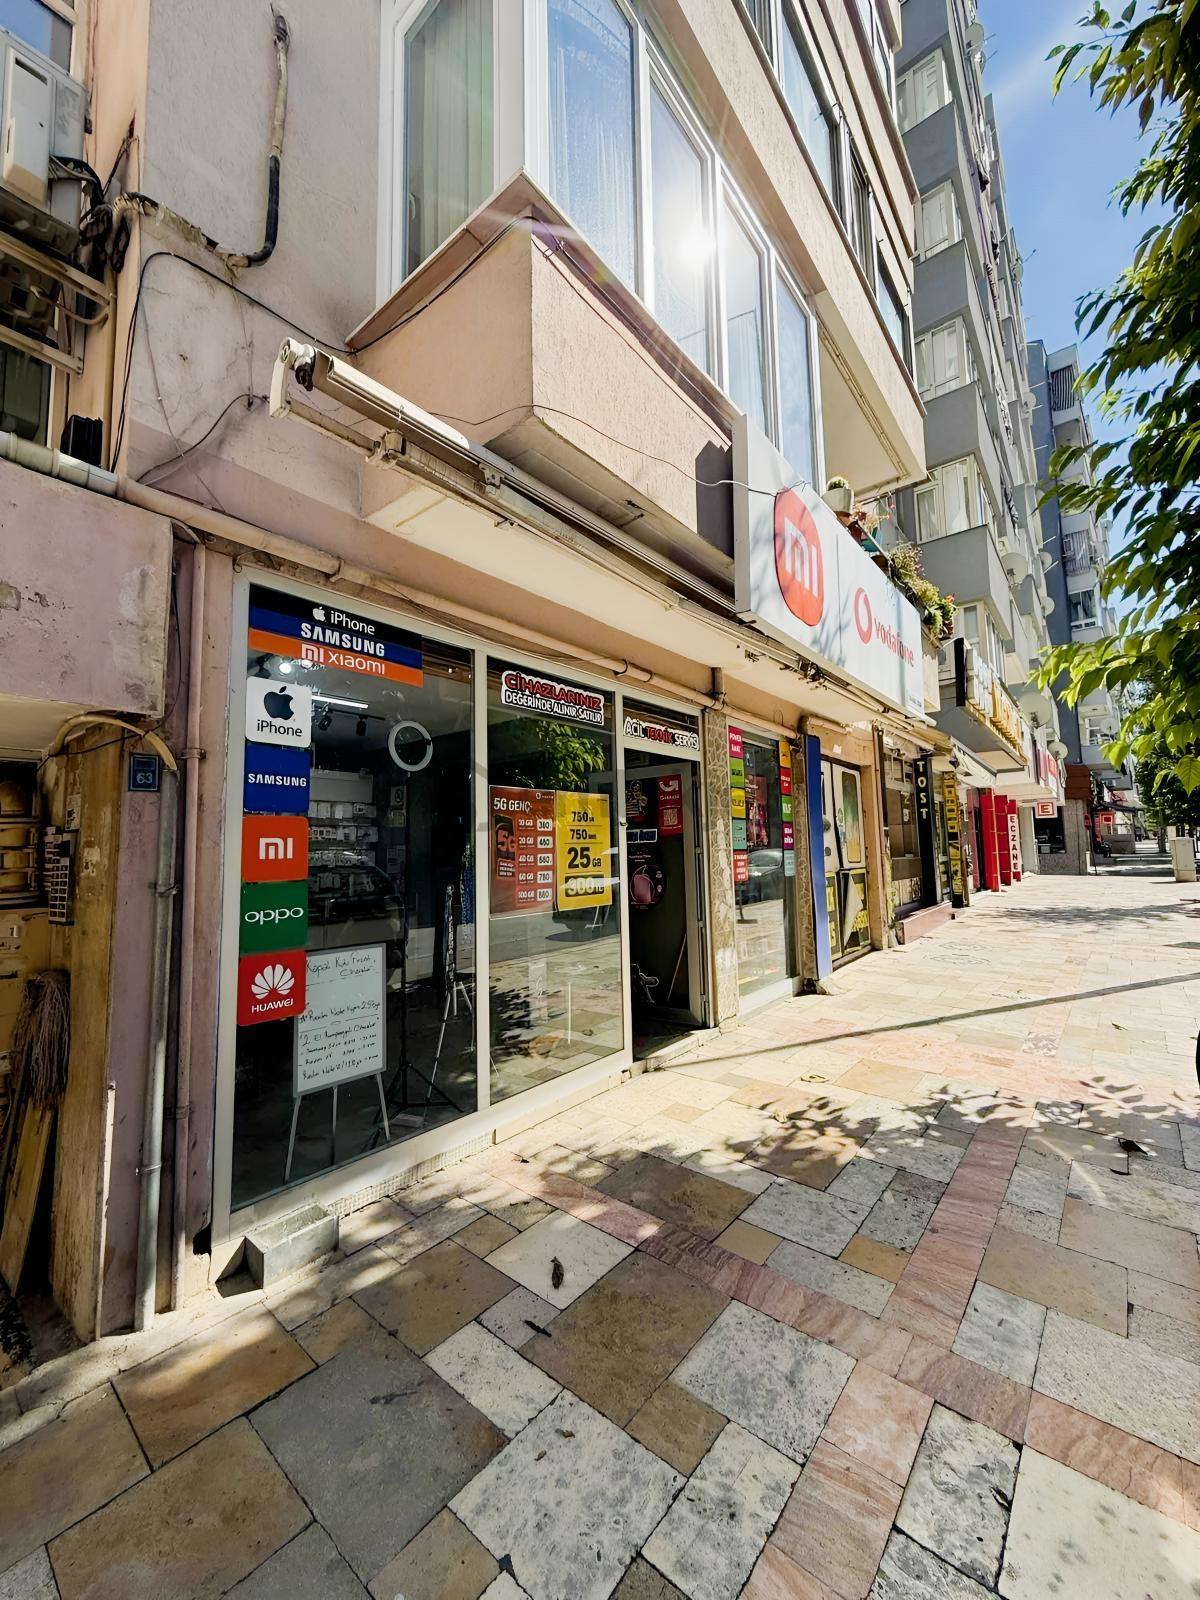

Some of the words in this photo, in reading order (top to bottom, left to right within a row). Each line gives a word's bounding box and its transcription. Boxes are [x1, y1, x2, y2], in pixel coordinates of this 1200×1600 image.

[330, 611, 375, 636] iPhone
[300, 622, 385, 657] SAMSUNG
[505, 689, 552, 712] DEĞERİNDE
[256, 719, 303, 737] iPhone
[136, 772, 153, 784] 63
[248, 773, 307, 787] SAMSUNG
[916, 761, 930, 820] TOST
[494, 797, 507, 811] 5G
[508, 799, 531, 814] GENÇ
[1040, 804, 1051, 814] E
[571, 811, 589, 823] 750
[570, 829, 588, 840] 750
[1009, 815, 1019, 870] ECZANE
[567, 846, 591, 869] 25
[592, 858, 602, 868] GB
[244, 907, 304, 925] oppo
[251, 998, 294, 1014] HUAWEI
